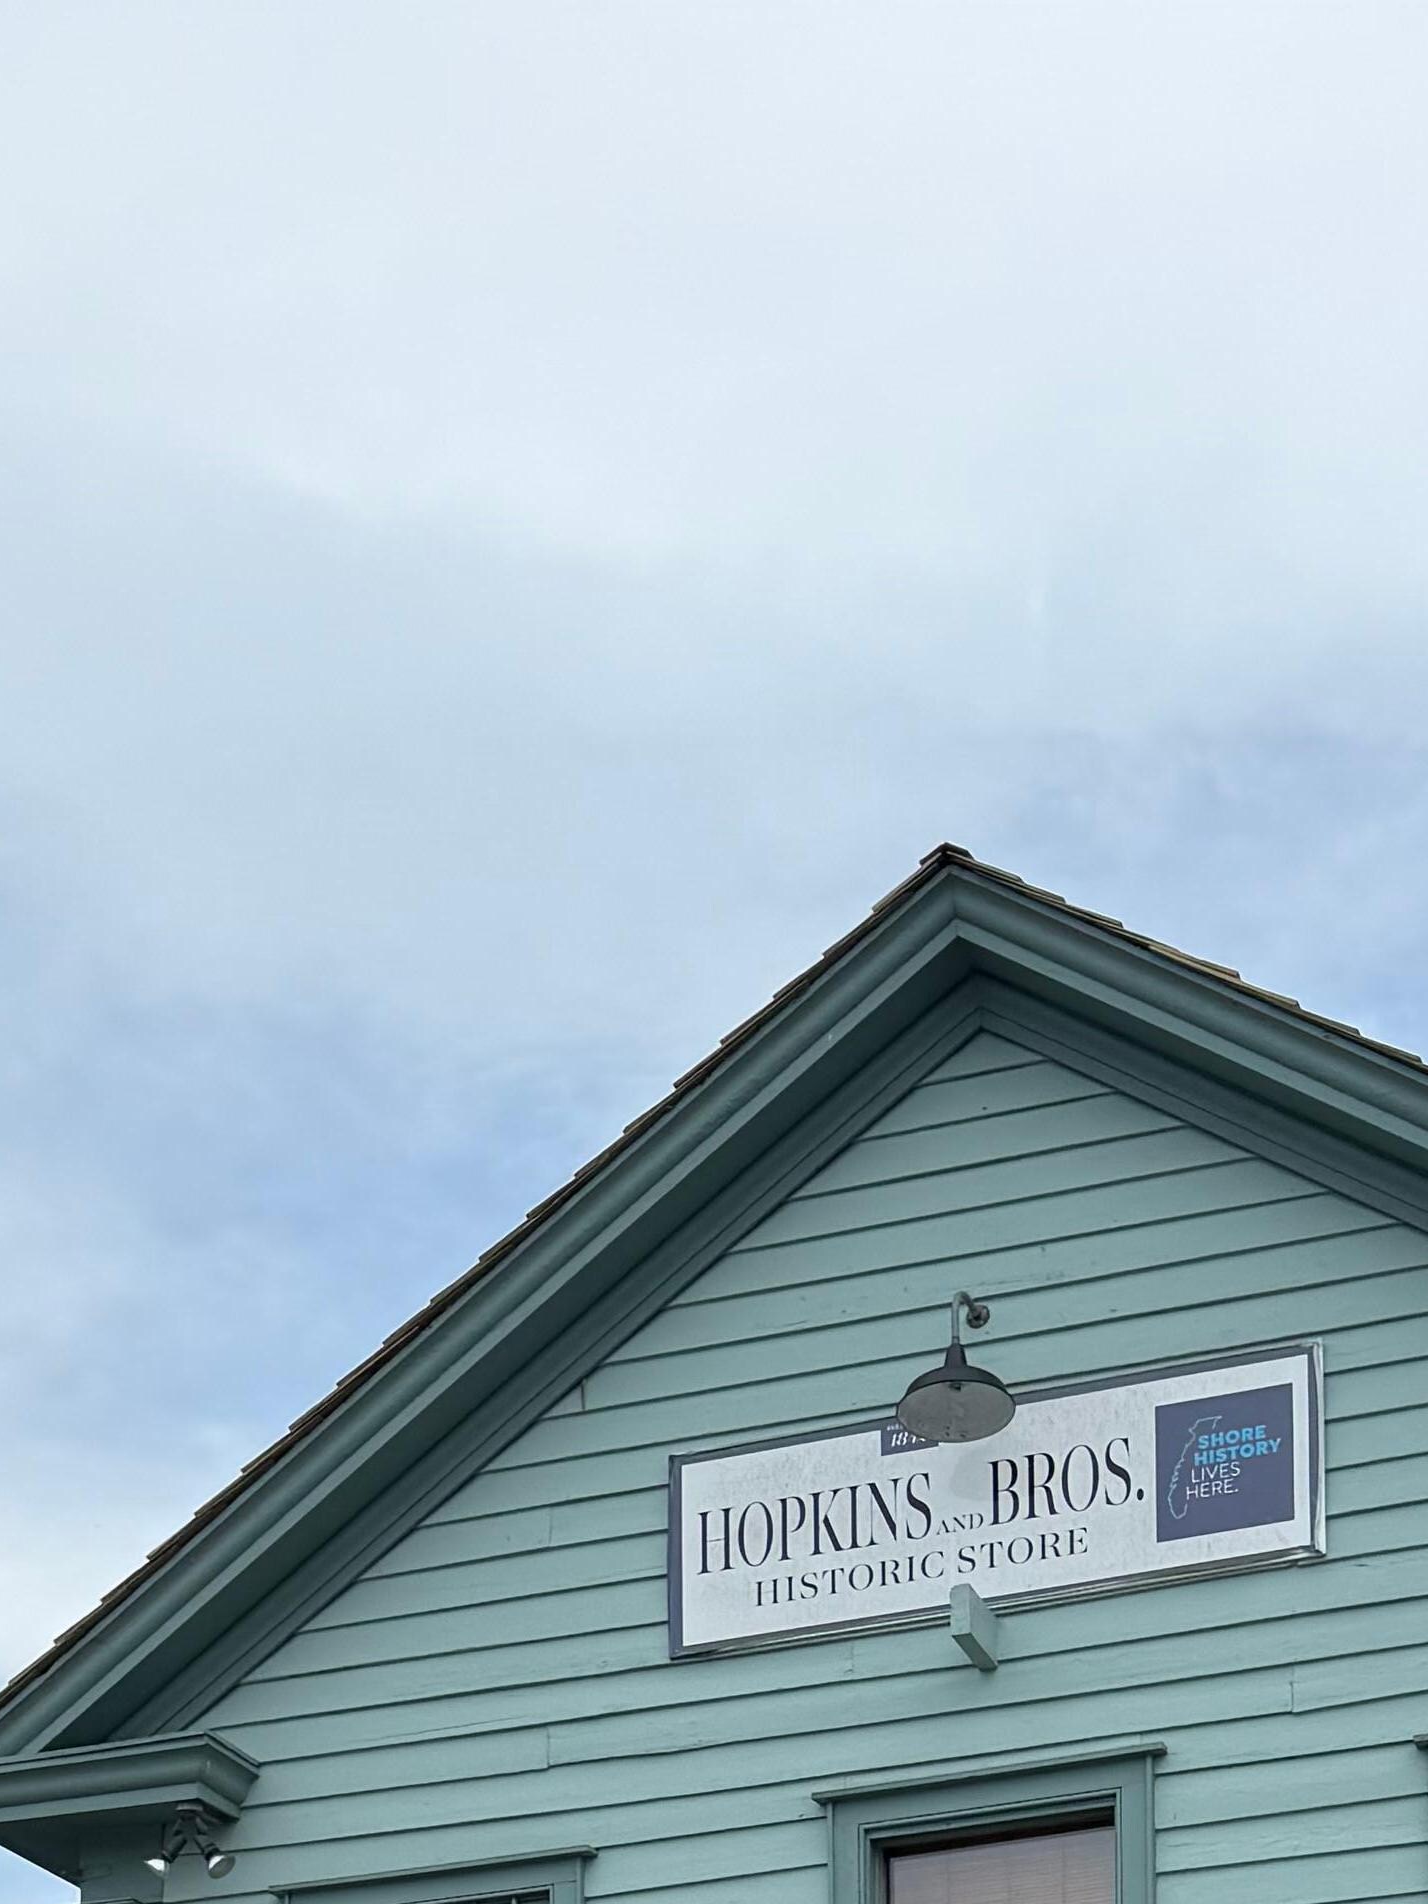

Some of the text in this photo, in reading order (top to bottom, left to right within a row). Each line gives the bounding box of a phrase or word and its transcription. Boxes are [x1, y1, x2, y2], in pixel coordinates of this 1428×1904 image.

[1197, 1424, 1267, 1450] SHORE
[1193, 1437, 1282, 1467] HISTORY
[1191, 1461, 1241, 1483] LIVES
[1185, 1478, 1239, 1500] HERE.
[697, 1437, 1145, 1575] HOPKINS AND BROS.
[756, 1527, 1089, 1607] HISTORIC STORE
